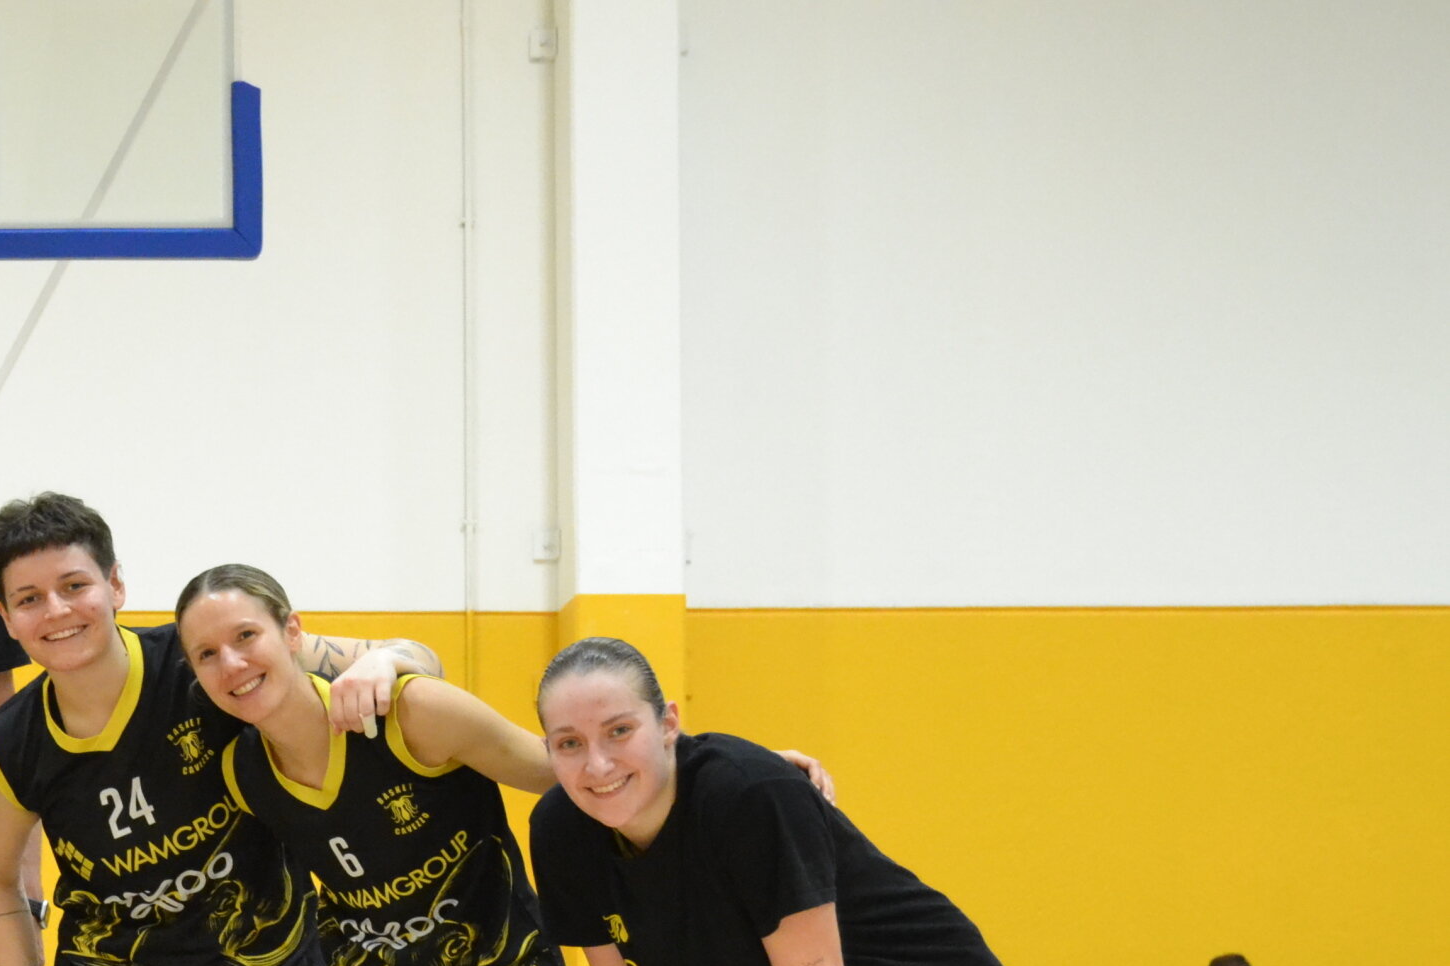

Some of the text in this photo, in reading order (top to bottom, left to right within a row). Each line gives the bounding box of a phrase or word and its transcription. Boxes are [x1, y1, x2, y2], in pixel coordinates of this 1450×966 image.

[99, 776, 157, 840] 24
[101, 795, 240, 877] WAMGROU
[328, 836, 365, 878] 6
[338, 830, 469, 909] WAMGROUP
